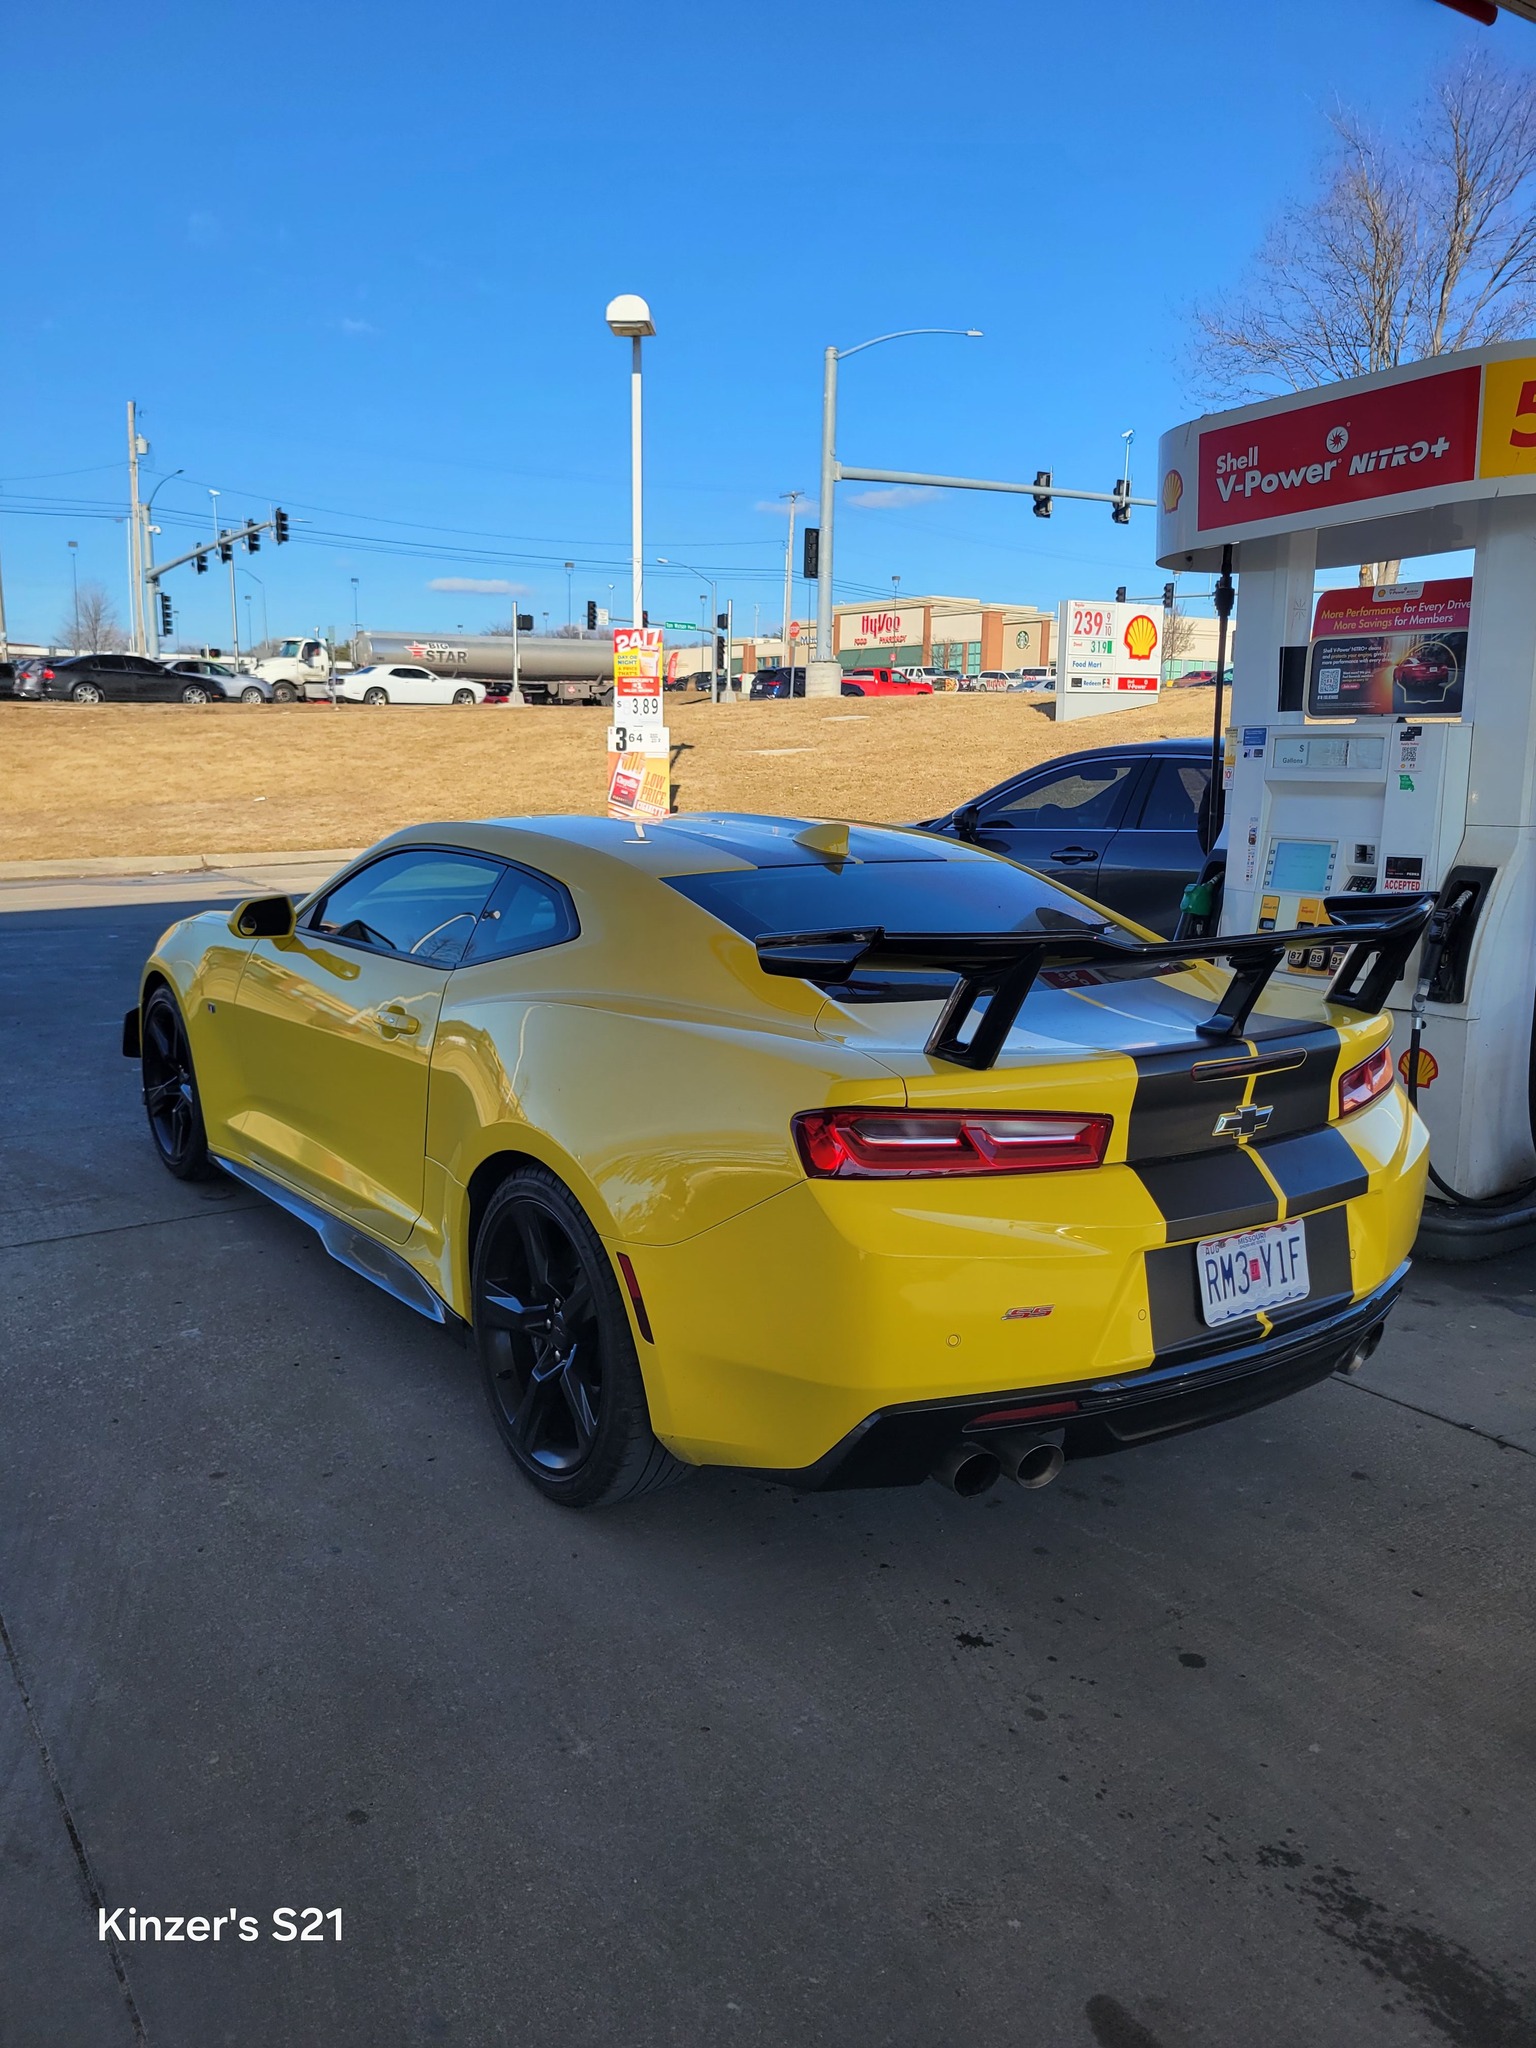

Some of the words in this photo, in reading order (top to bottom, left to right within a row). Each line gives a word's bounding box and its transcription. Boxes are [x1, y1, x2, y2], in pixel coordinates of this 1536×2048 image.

[1216, 446, 1258, 474] Shell
[1216, 460, 1338, 502] V-Power
[1107, 612, 1111, 622] 9
[1321, 610, 1343, 619] More
[1346, 606, 1401, 618] Performance
[1403, 602, 1417, 613] for
[1419, 600, 1444, 613] Every
[1447, 599, 1471, 609] Drive
[1074, 610, 1103, 636] 239
[1333, 620, 1356, 630] More
[1358, 618, 1392, 630] Savings
[1394, 616, 1407, 626] for
[1409, 613, 1453, 625] Members
[1105, 626, 1112, 636] 10
[1091, 640, 1107, 653] 319
[426, 650, 468, 663] STAR
[632, 698, 659, 716] 3.89
[616, 727, 627, 751] 3
[629, 733, 643, 742] 64
[645, 771, 666, 790] LOW
[640, 786, 667, 806] PRICE
[1384, 880, 1420, 891] ACCEPTED
[1290, 951, 1302, 960] 87
[1310, 954, 1322, 963] 89
[1238, 1232, 1267, 1245] MISSOURI
[1205, 1245, 1220, 1256] AUG
[1205, 1251, 1250, 1305] RM3
[1260, 1236, 1300, 1288] Y1F
[1001, 1303, 1056, 1321] SS
